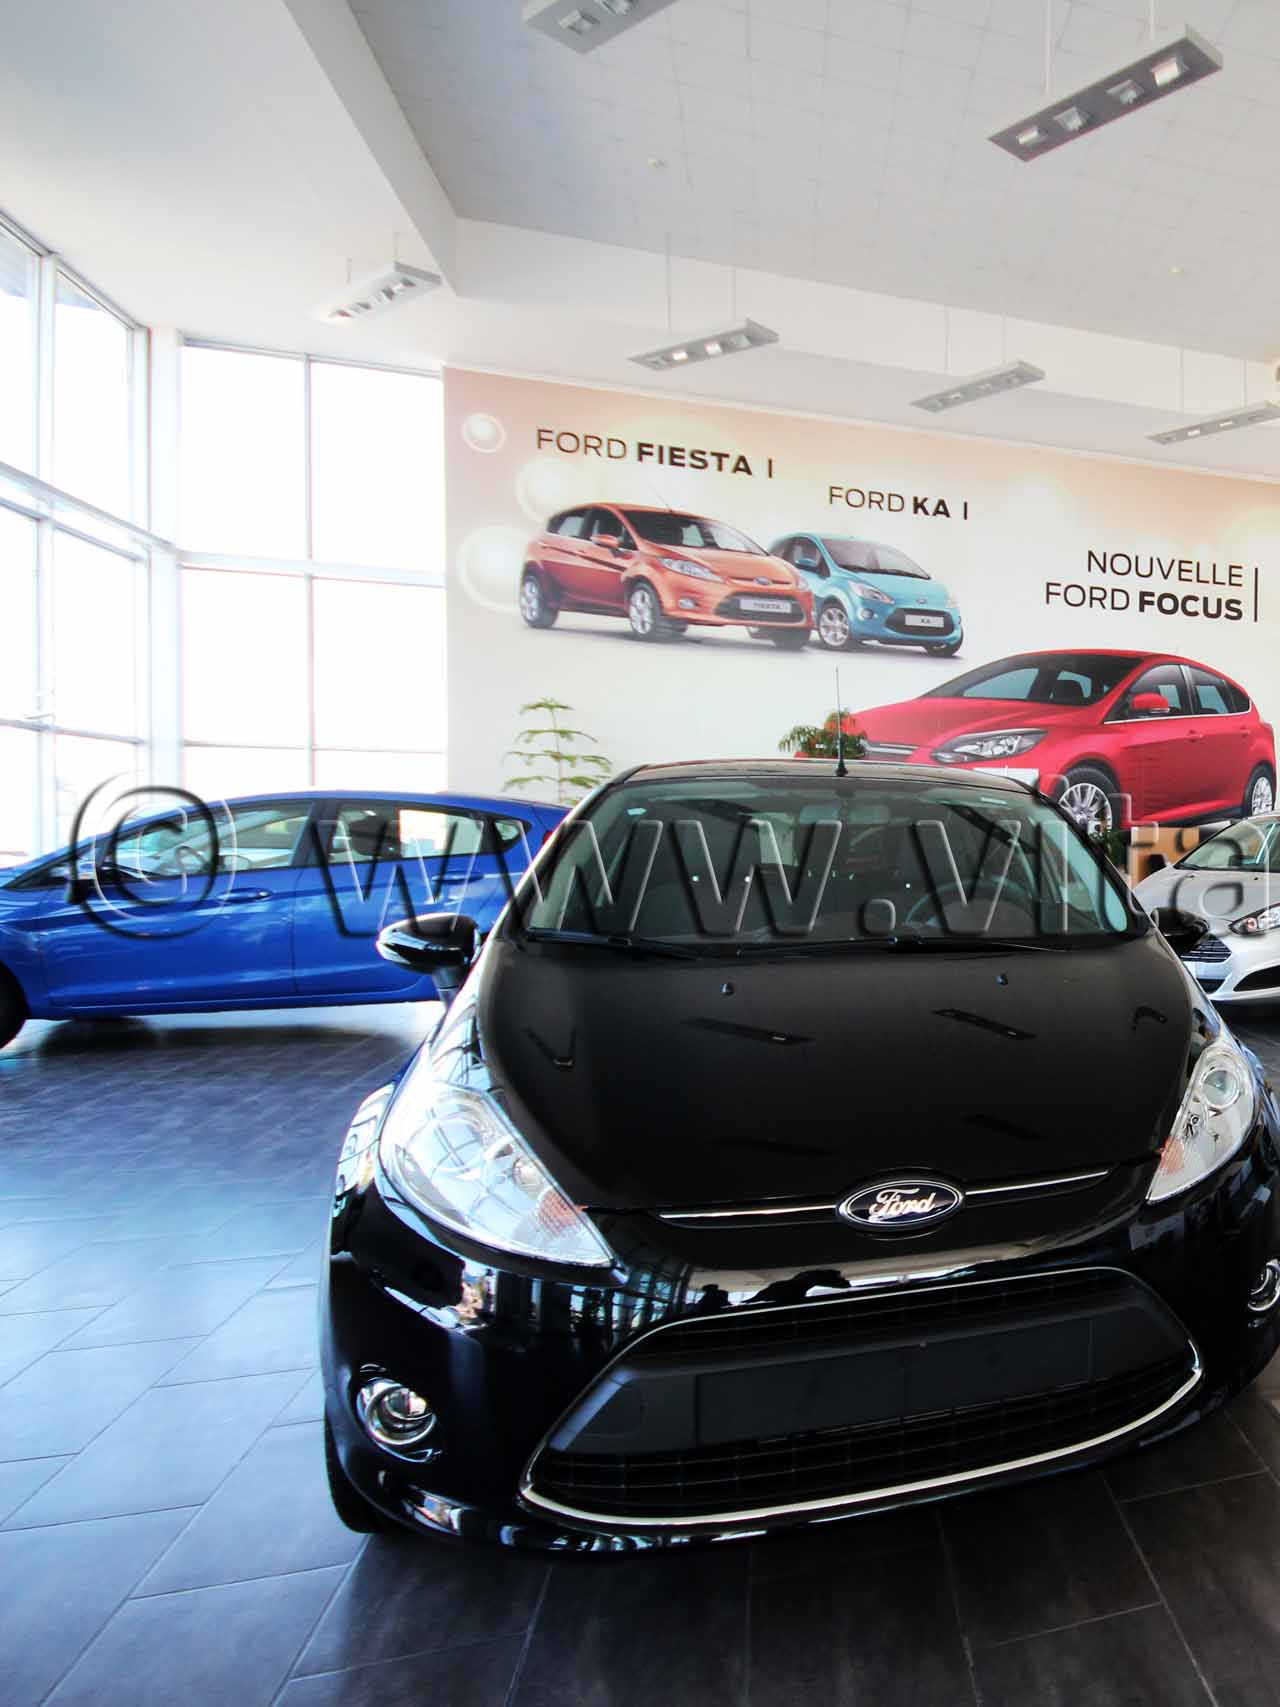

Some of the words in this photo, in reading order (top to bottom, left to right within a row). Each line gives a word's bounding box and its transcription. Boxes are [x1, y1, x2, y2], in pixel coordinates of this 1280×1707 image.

[536, 428, 627, 460] FORD
[636, 442, 753, 476] FIESTA
[828, 485, 905, 513] FORD
[912, 496, 952, 519] KA
[1087, 549, 1243, 587] NOUVELLE
[1045, 581, 1130, 611] FORD
[1138, 591, 1243, 621] FOCUS
[868, 1187, 937, 1223] Ford
